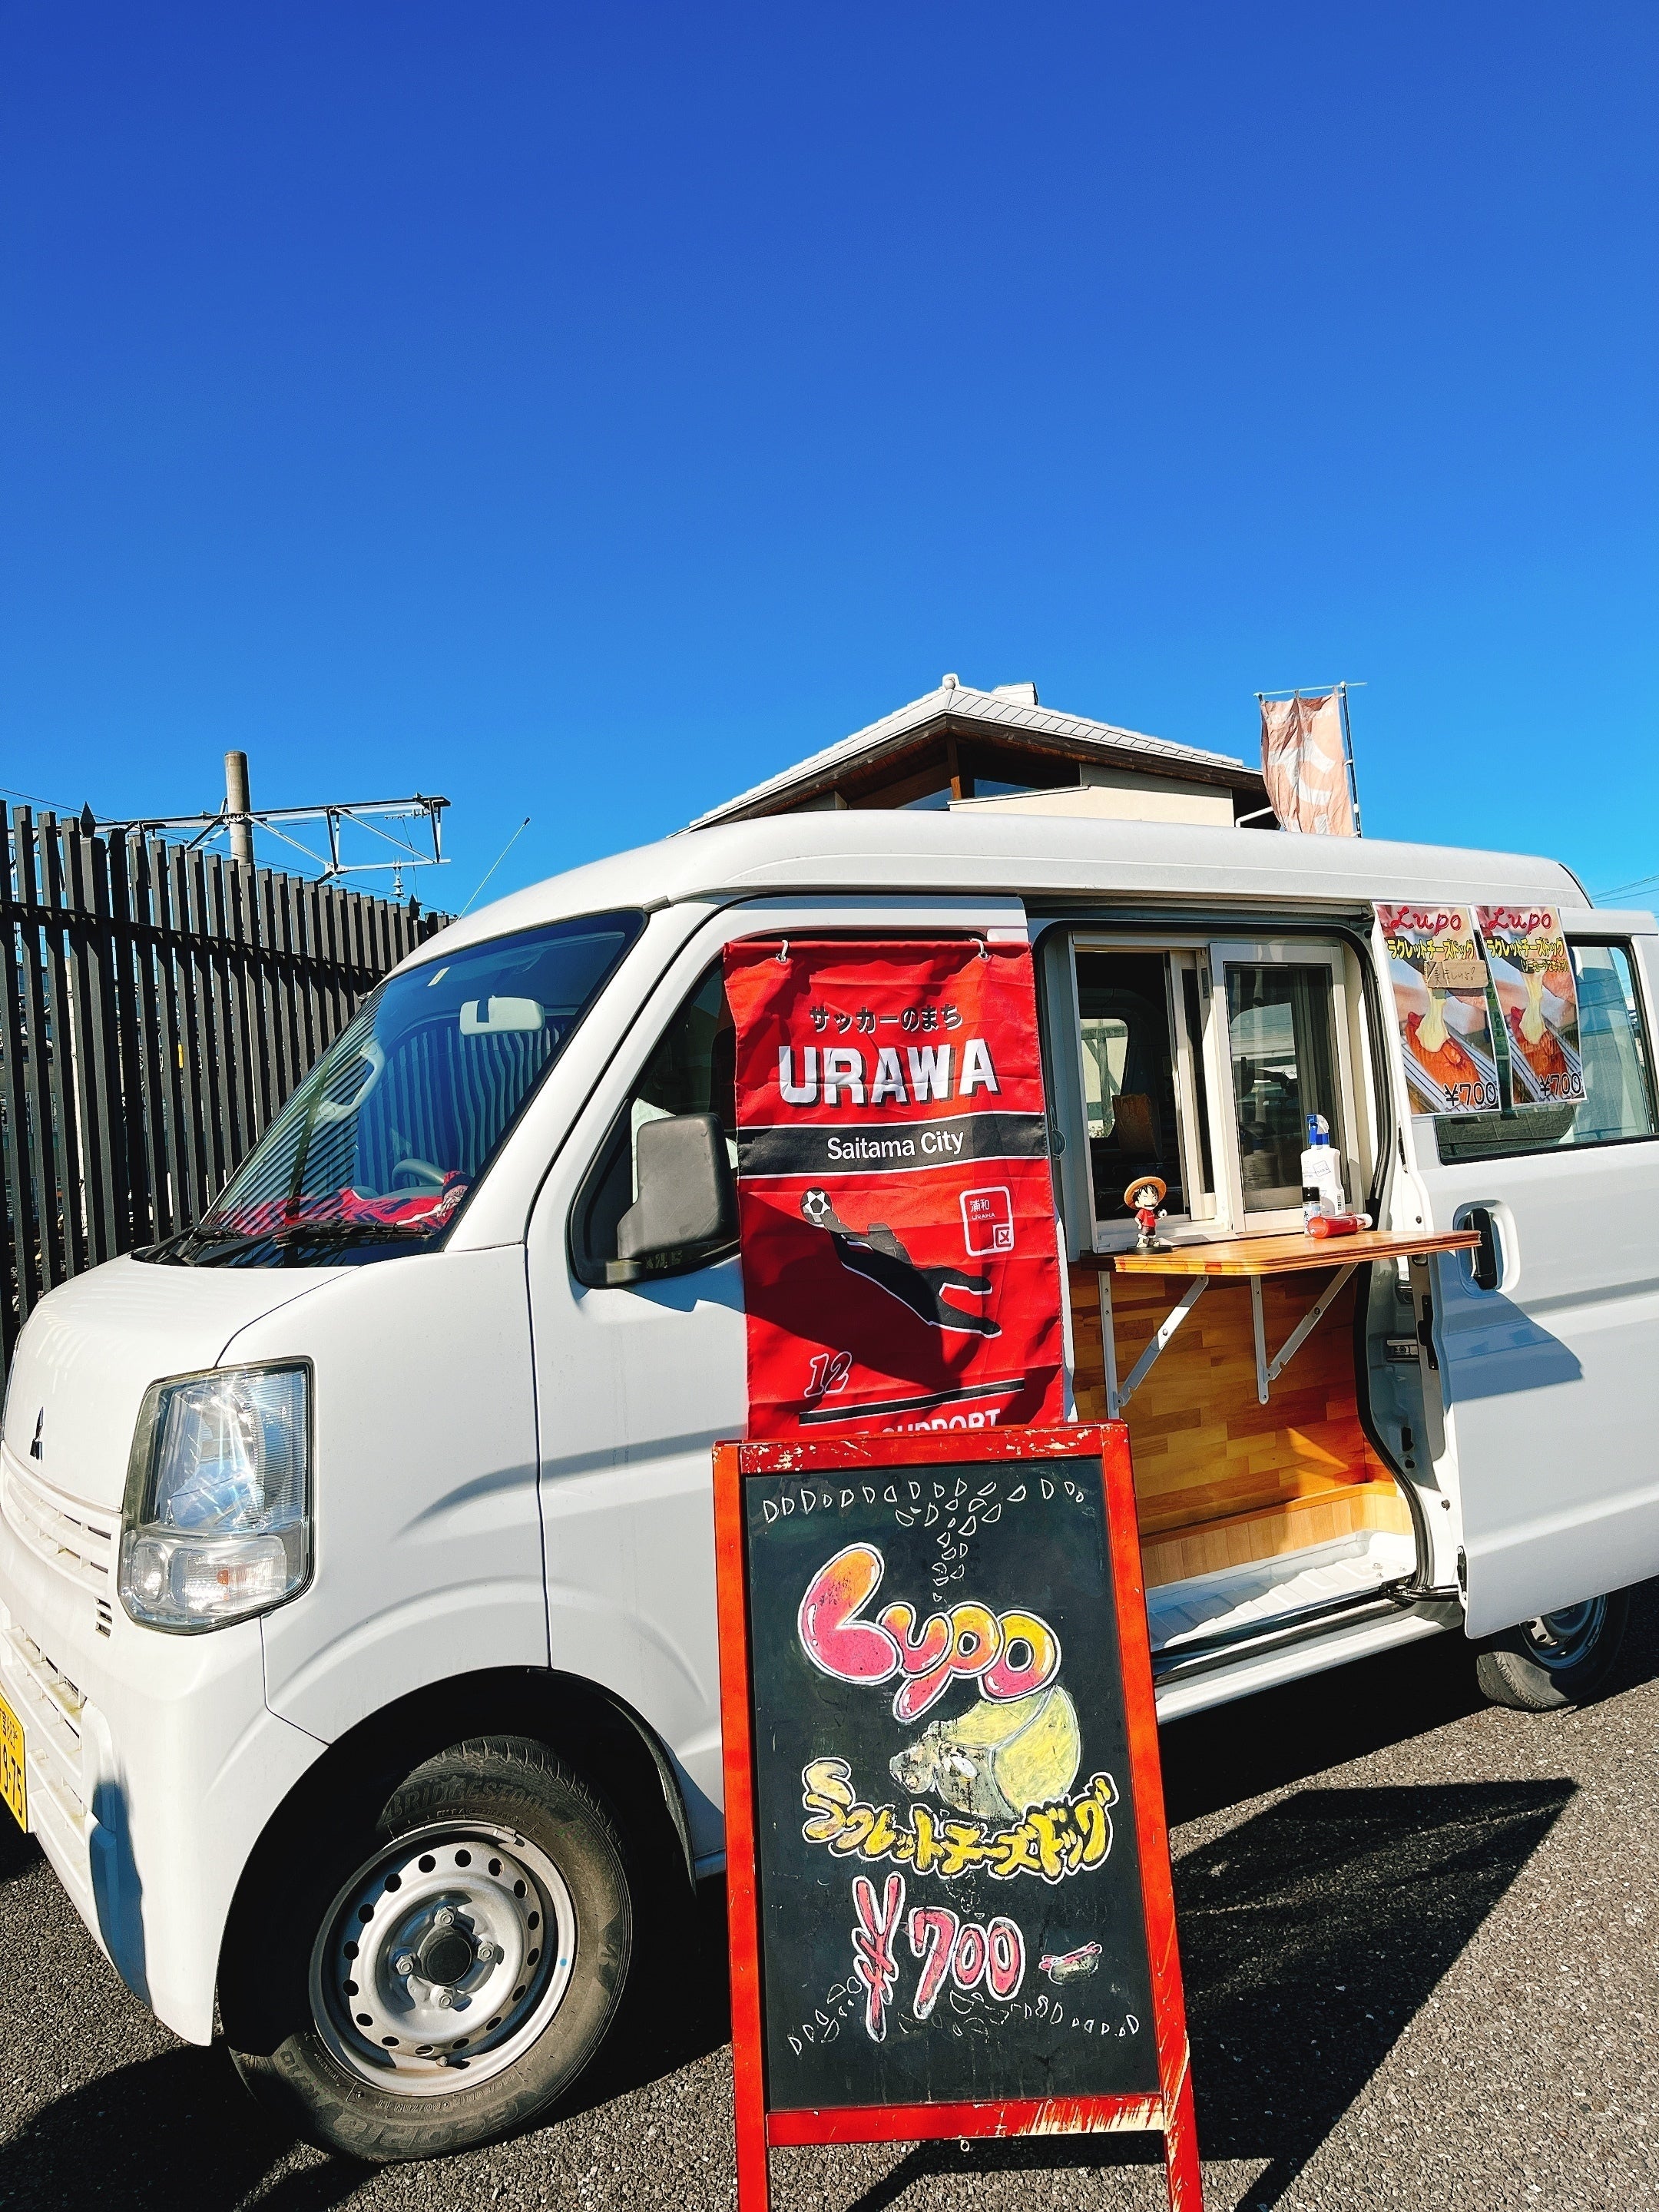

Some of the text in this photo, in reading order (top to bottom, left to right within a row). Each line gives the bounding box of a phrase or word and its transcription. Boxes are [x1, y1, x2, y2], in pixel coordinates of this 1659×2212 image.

[1391, 906, 1462, 935] Lupo
[1488, 906, 1552, 935] Lupo
[1387, 938, 1474, 960] ラクレットチーズドッグ
[1486, 937, 1565, 959] ラクレットチーズドッグ
[810, 1002, 963, 1034] サッカーのまち
[779, 1038, 1002, 1107] URAWA
[1539, 1072, 1581, 1097] ¥700
[1443, 1081, 1497, 1107] ¥700
[827, 1131, 965, 1161] Saitama City
[969, 1198, 990, 1213] 浦和
[972, 1212, 996, 1220] URAWA
[805, 1349, 853, 1397] 12
[798, 1542, 1061, 1724] Lupo
[802, 1757, 1121, 1885] ラクレットチーズドッグ
[853, 1872, 1026, 2041] ¥700
